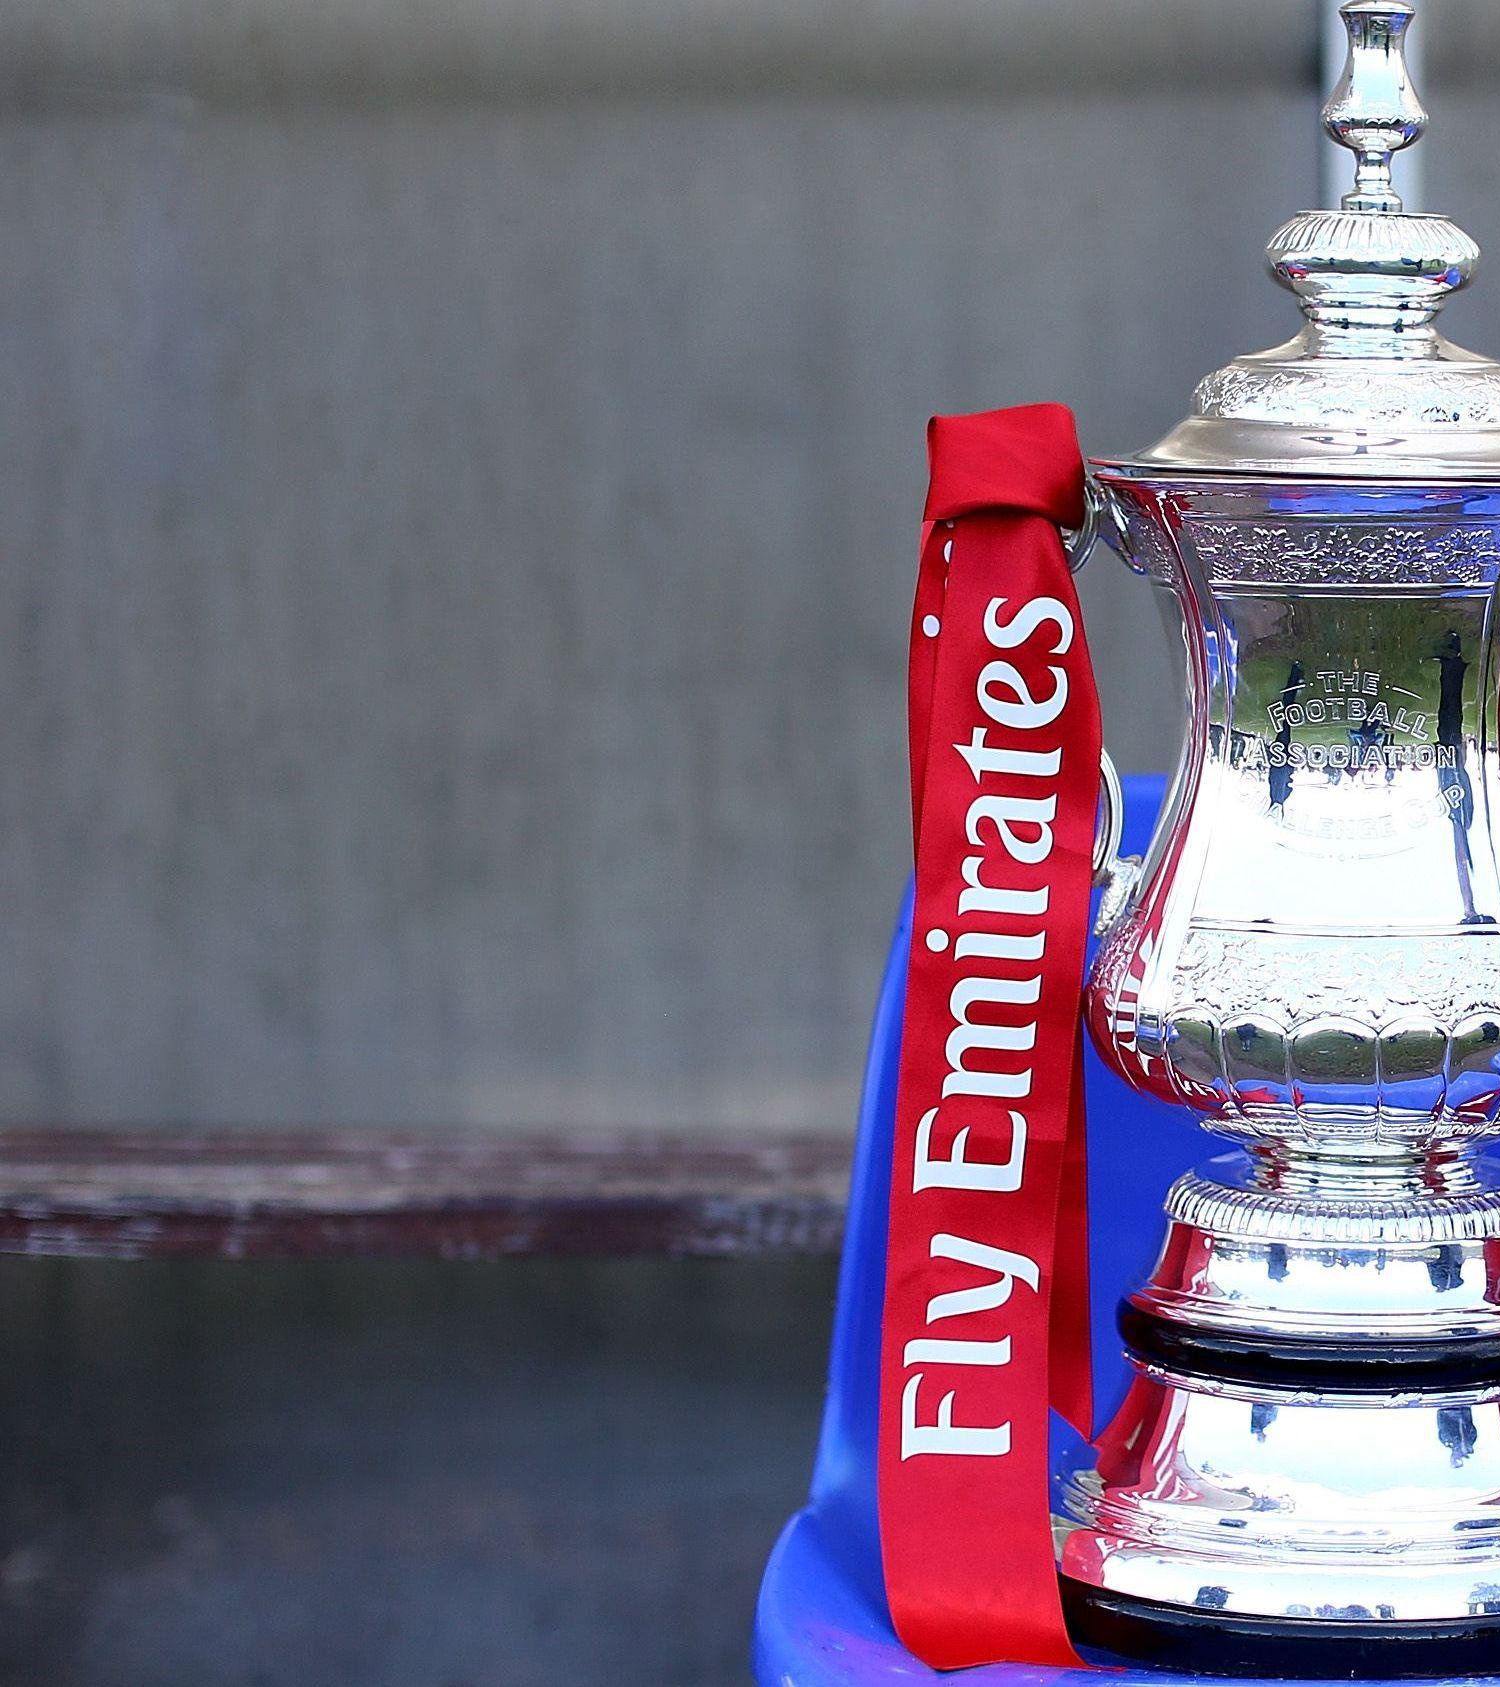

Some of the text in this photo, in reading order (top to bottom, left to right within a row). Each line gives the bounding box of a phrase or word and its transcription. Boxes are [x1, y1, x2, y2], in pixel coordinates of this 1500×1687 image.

[1316, 671, 1381, 696] THE
[1265, 697, 1430, 742] FOOTBALL
[1246, 736, 1457, 769] ASSOCIATION
[901, 596, 1075, 1462] Fly Emirates
